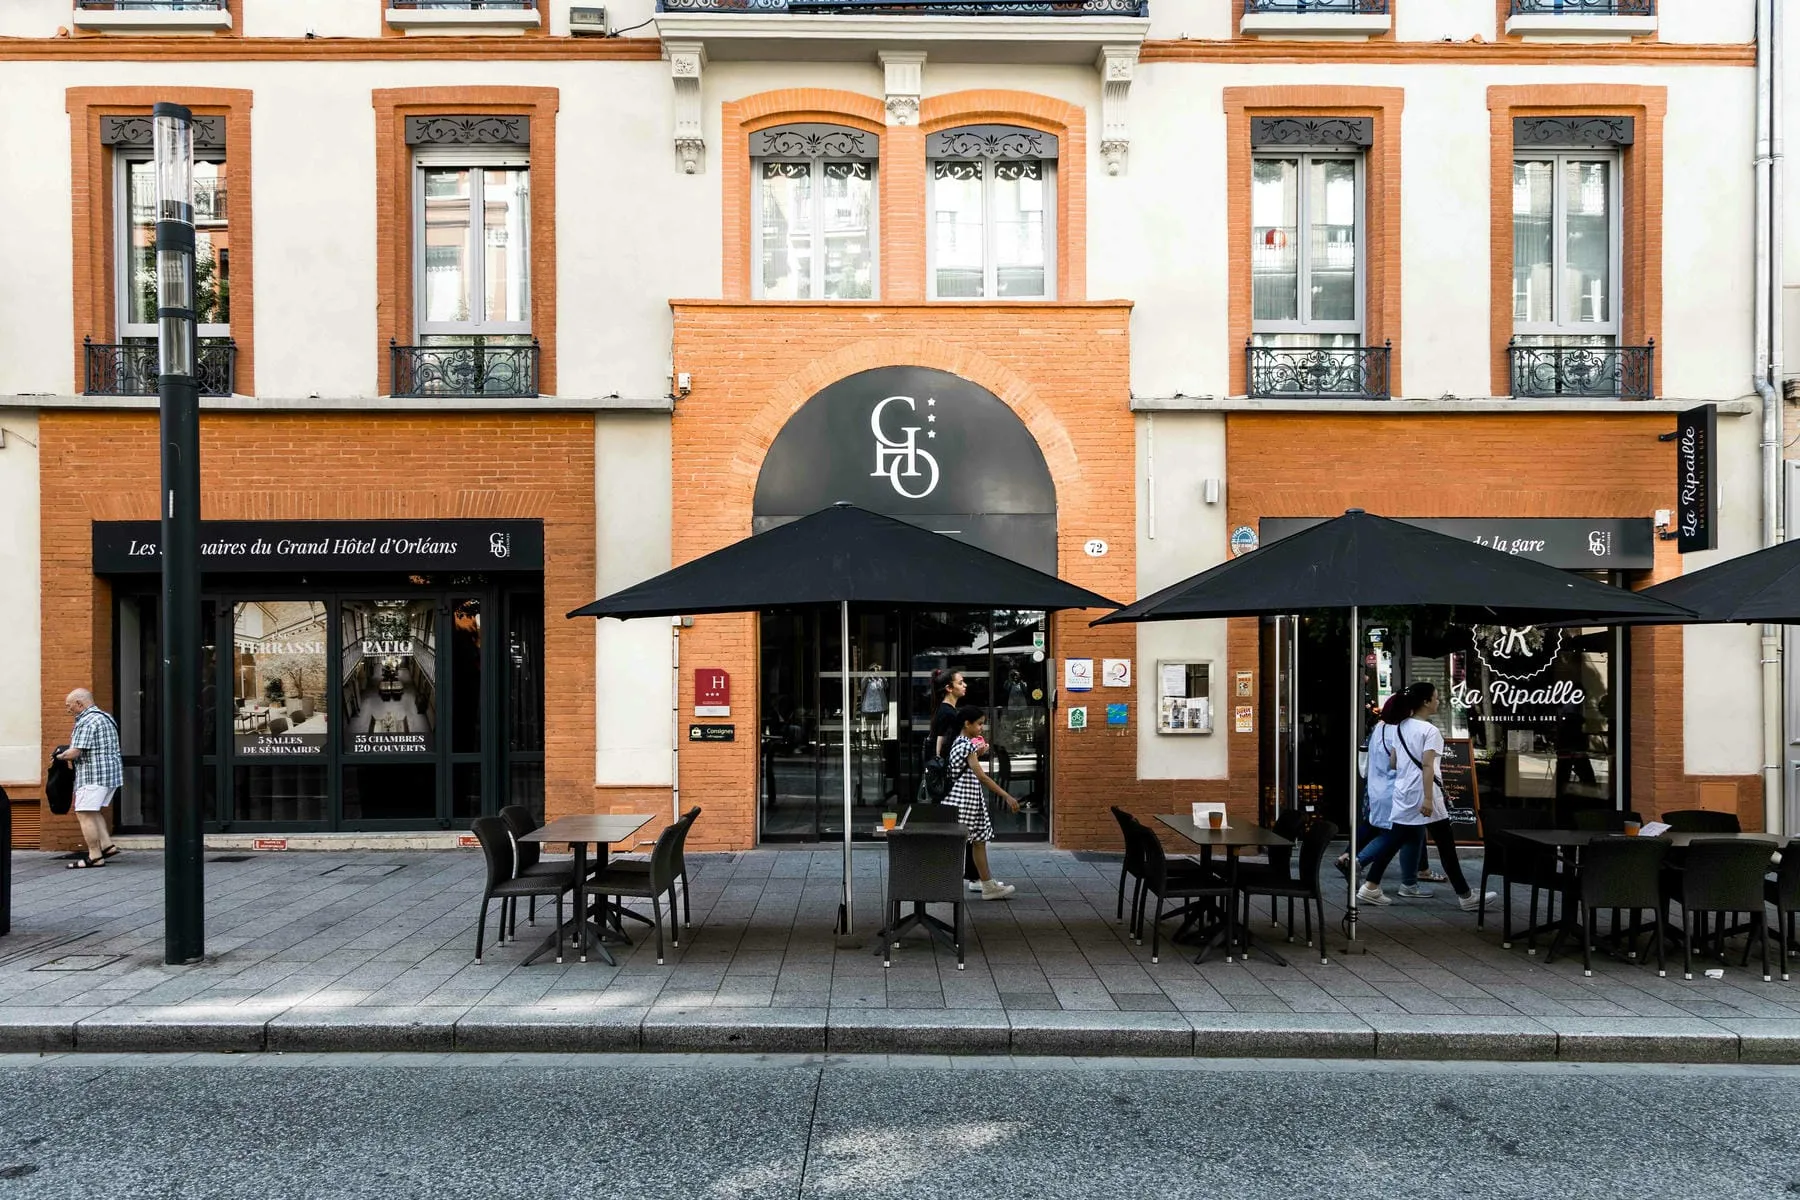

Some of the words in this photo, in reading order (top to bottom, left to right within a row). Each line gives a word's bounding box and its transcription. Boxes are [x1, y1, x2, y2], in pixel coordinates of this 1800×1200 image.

[1681, 426, 1700, 505] Ripaille
[1681, 509, 1698, 537] La
[128, 540, 156, 556] Les
[159, 538, 247, 556] naires
[250, 538, 272, 555] du
[277, 538, 330, 555] Grand
[333, 537, 377, 555] Hôtel
[380, 537, 458, 555] d'Orléans
[1090, 542, 1103, 553] 72
[1492, 535, 1507, 552] la
[1509, 538, 1545, 555] gare
[240, 641, 325, 654] TERRASSE
[362, 640, 414, 654] PATIO
[712, 675, 725, 689] H
[1450, 680, 1483, 709] La
[1489, 680, 1586, 714] Ripaille
[706, 727, 734, 735] Consignes
[258, 736, 265, 744] 5
[266, 736, 303, 744] SALLES
[355, 735, 367, 743] 55
[368, 735, 425, 743] CHAMBRES
[243, 746, 257, 754] DE
[260, 744, 321, 754] SÉMINAIRES
[354, 744, 371, 753] 120
[372, 744, 427, 753] COUVERTS
